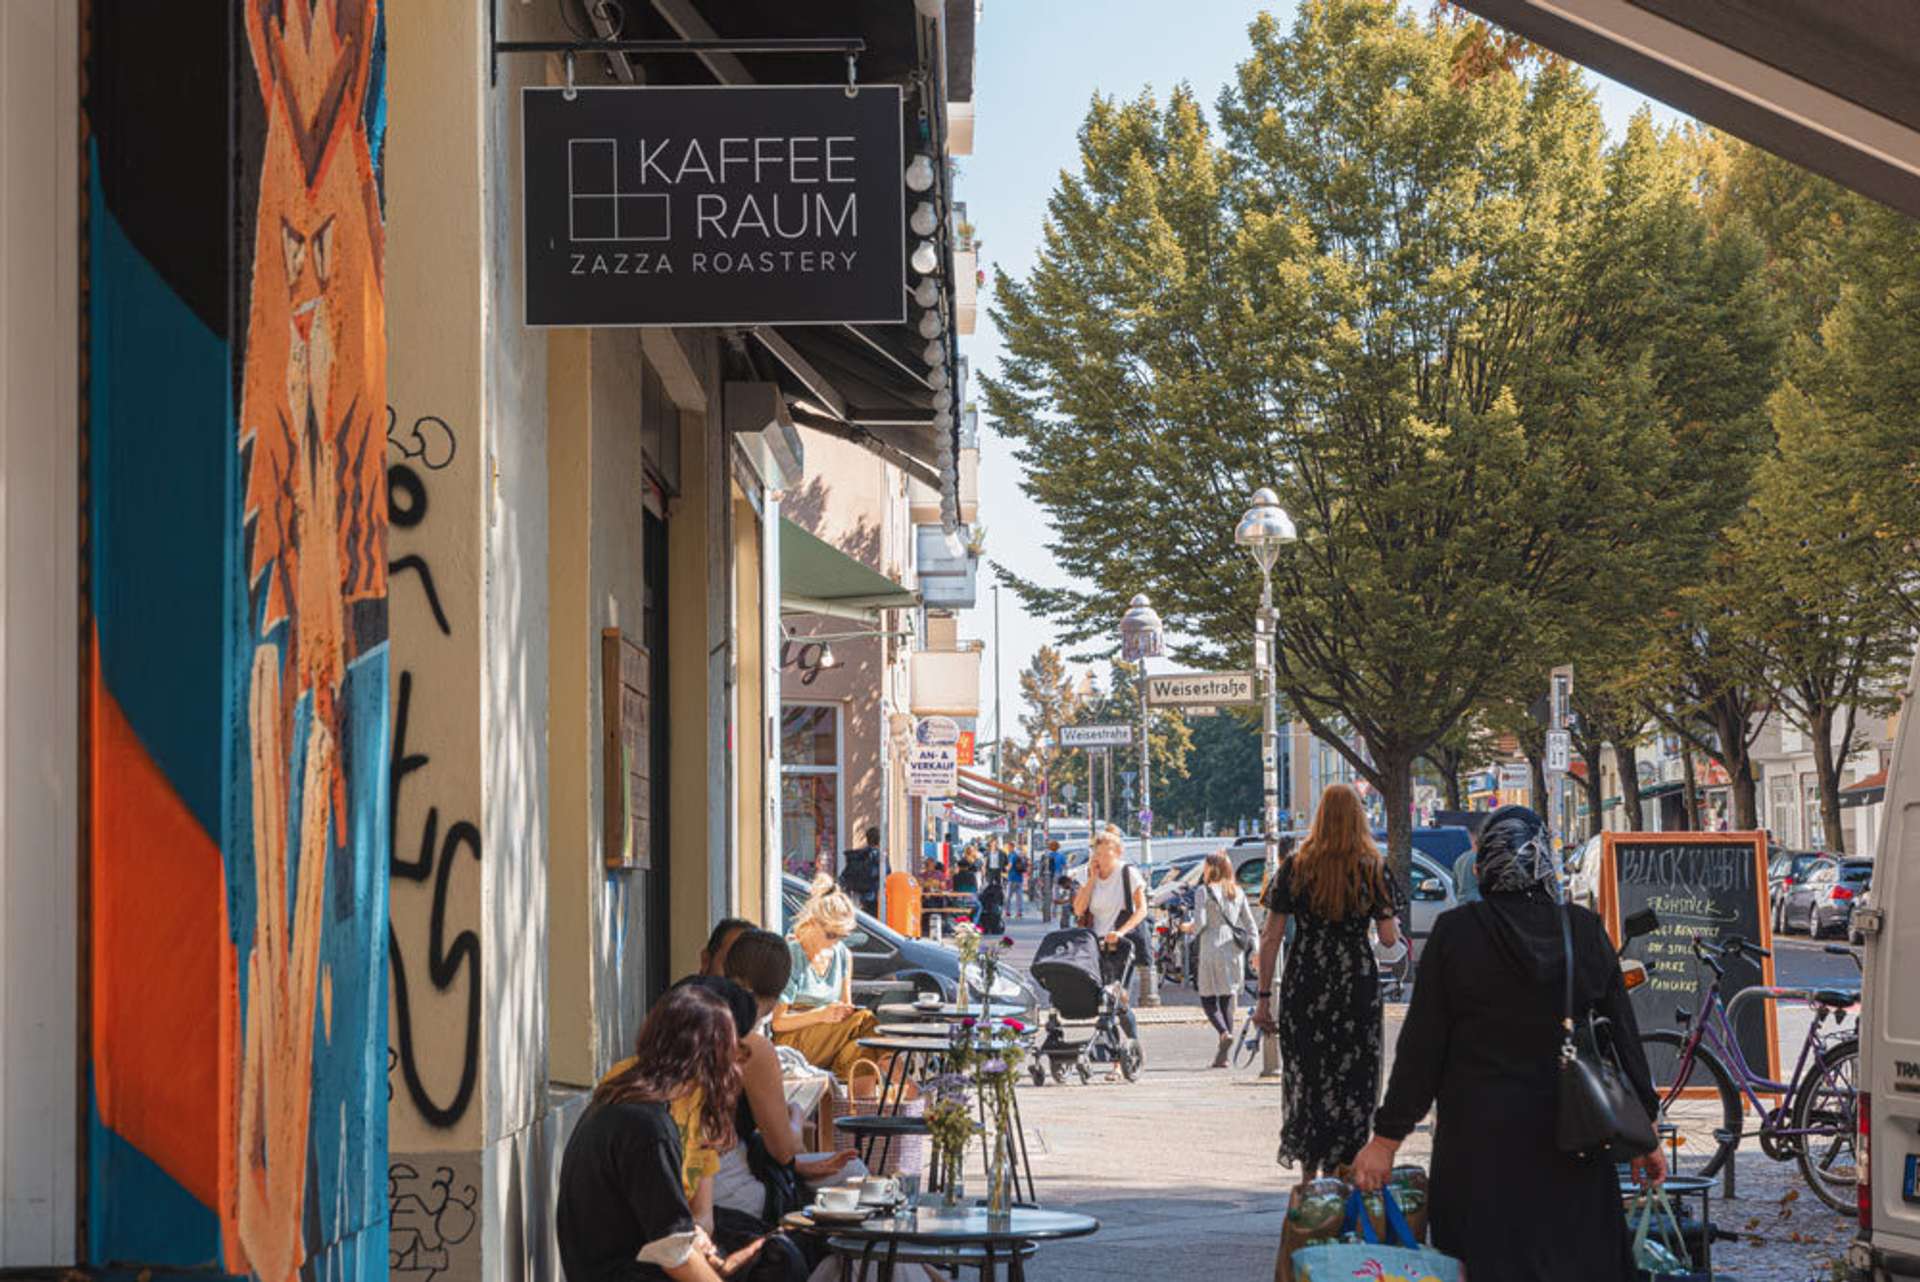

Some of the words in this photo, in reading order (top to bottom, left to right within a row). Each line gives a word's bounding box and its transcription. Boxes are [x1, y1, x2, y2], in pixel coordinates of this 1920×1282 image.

[640, 136, 857, 185] KAFFEE
[696, 192, 858, 240] RAUM
[570, 253, 673, 275] ZAZZA
[692, 250, 858, 274] ROASTERY
[1154, 678, 1247, 698] Weisestraße
[910, 762, 955, 770] VERKAUF
